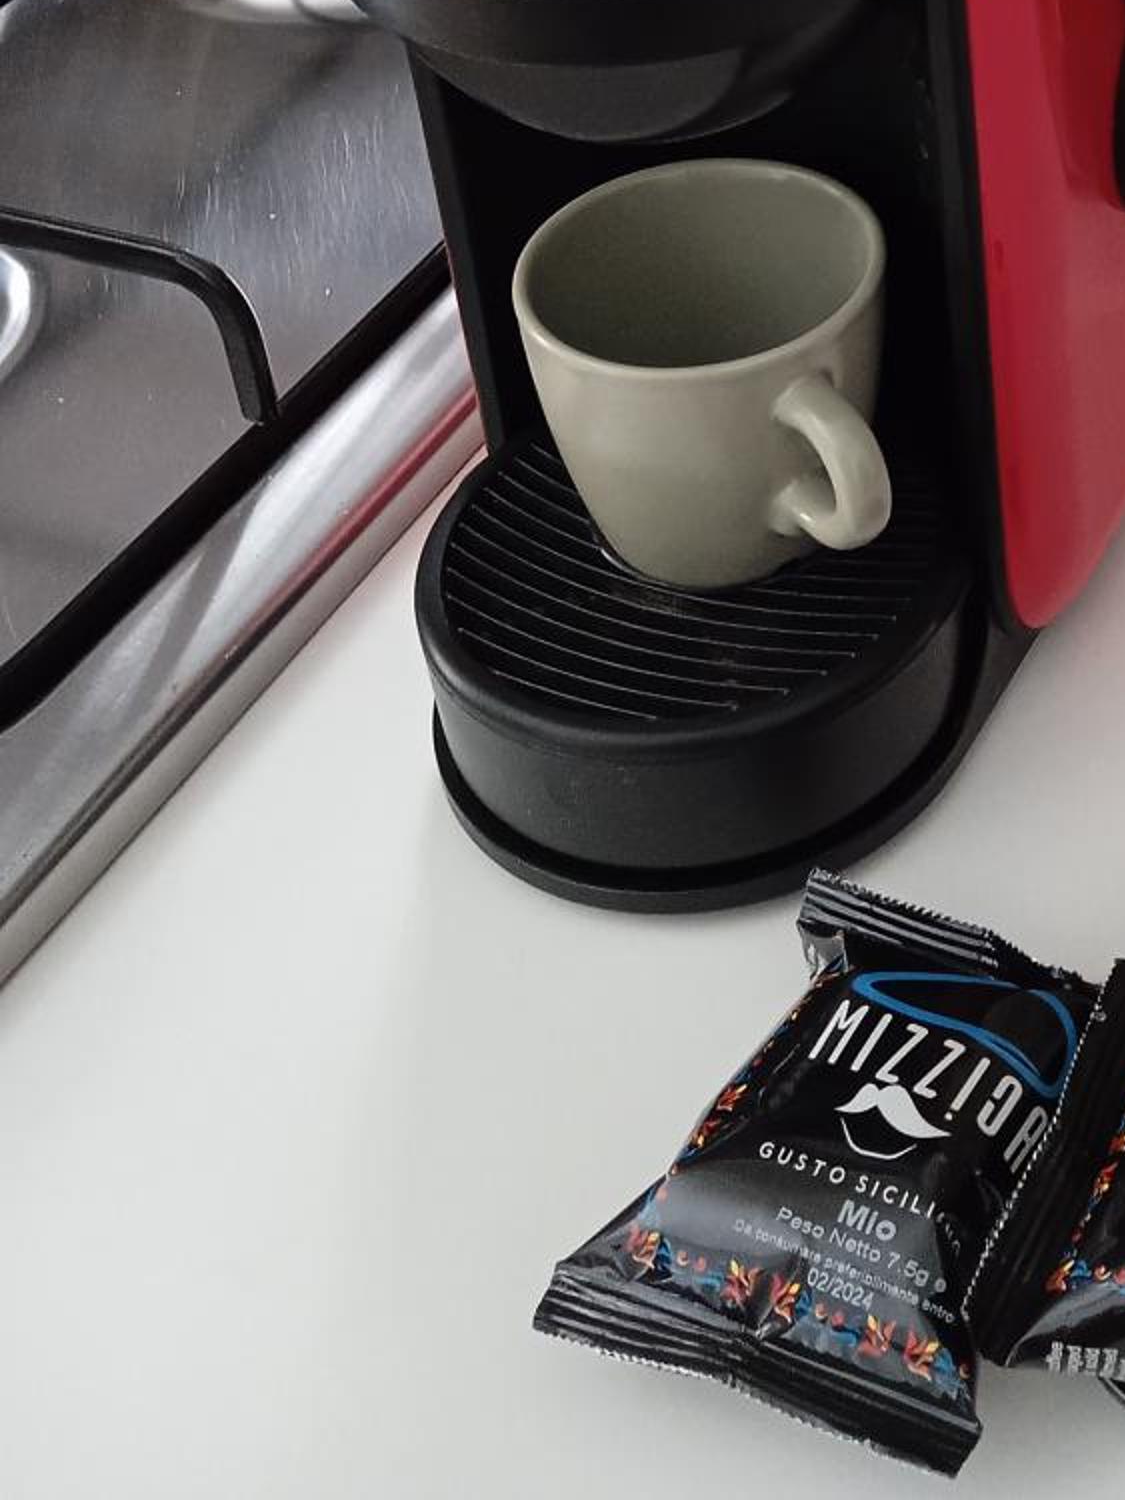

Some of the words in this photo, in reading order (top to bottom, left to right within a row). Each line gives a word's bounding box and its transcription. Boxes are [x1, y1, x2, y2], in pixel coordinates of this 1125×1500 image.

[758, 1140, 847, 1185] GUSTO
[775, 1205, 826, 1239] Peso
[829, 1227, 881, 1263] Netto
[887, 1251, 930, 1287] 7.5g
[806, 1267, 875, 1311] 02/2024
[921, 1297, 955, 1324] entro
